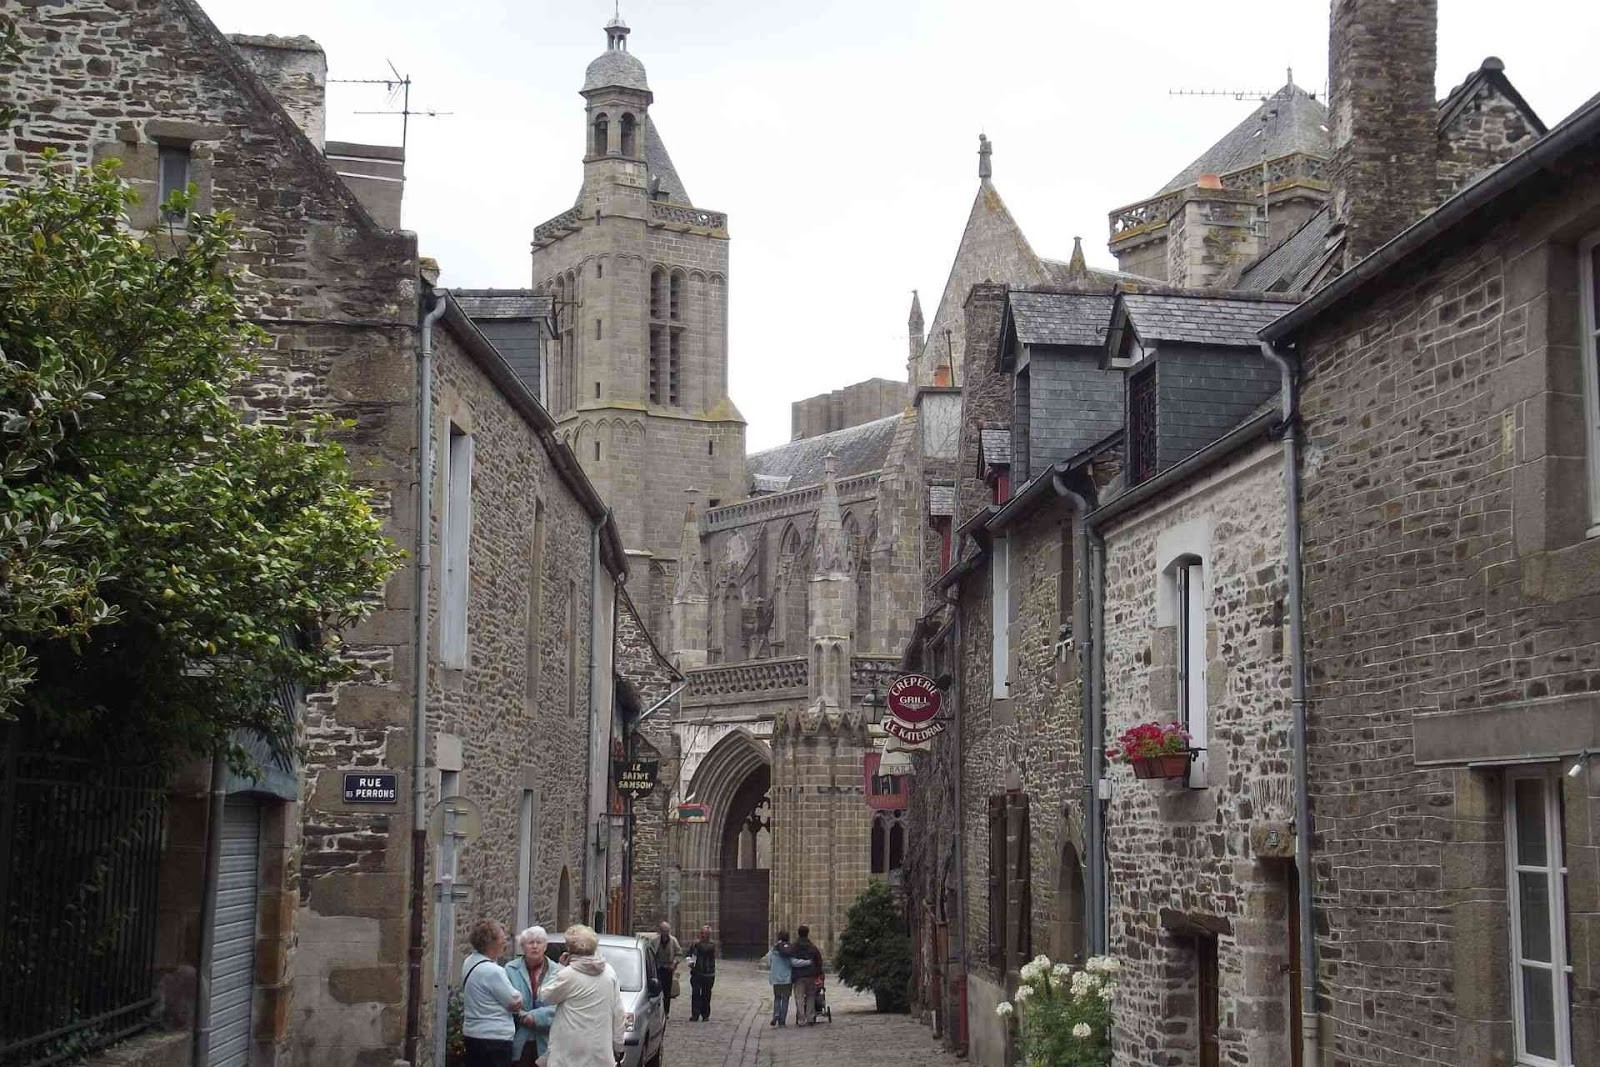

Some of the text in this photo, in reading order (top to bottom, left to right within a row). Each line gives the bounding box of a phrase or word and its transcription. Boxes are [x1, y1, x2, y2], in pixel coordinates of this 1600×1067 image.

[891, 677, 938, 697] CREPERIE
[899, 696, 927, 704] GRILL
[886, 721, 944, 741] LE KATEDRAL
[359, 778, 382, 787] RUE
[355, 789, 395, 798] PERRONS
